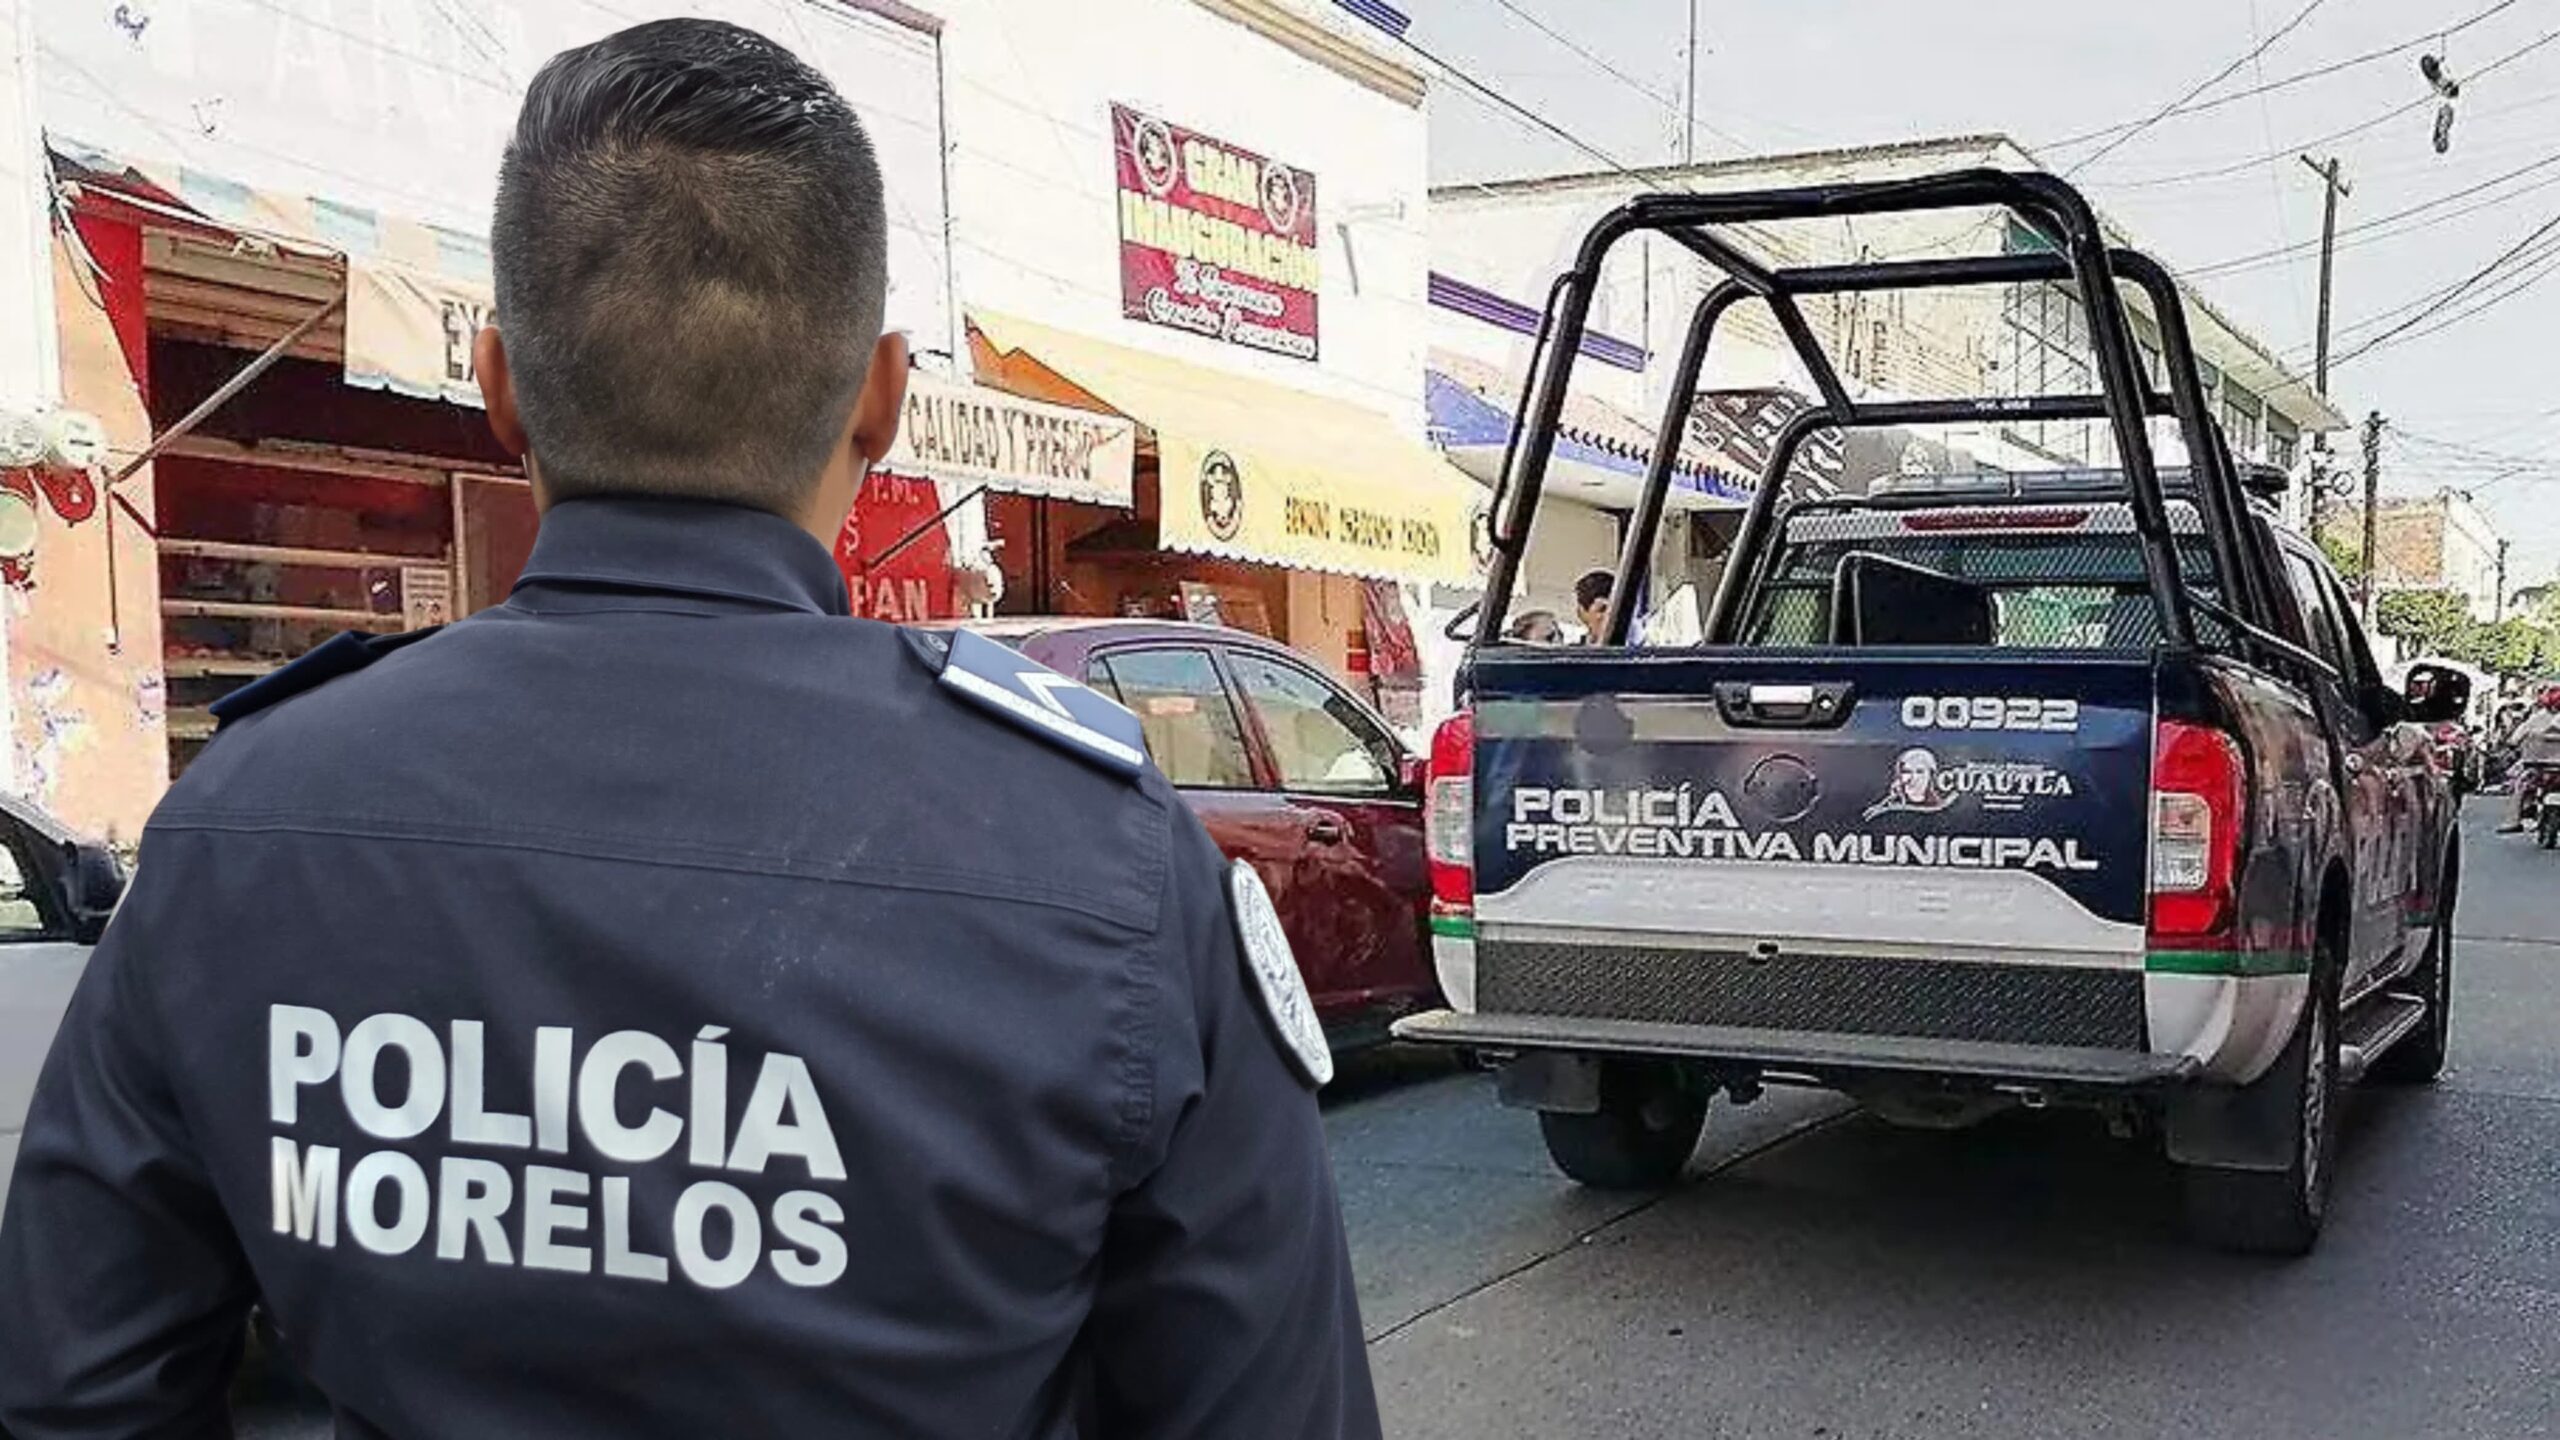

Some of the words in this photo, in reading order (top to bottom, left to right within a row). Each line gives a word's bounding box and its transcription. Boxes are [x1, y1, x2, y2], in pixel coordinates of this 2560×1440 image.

[1183, 139, 1260, 212] GRAN
[908, 392, 1000, 469] CALIDAD
[1003, 409, 1018, 474] Y
[1902, 696, 2078, 731] 00922
[1514, 782, 1739, 827] POLICÍA
[1937, 767, 2073, 795] CUAUTLA
[1506, 823, 1801, 860] PREVENTIVA
[1813, 833, 2099, 869] MUNICIPAL
[269, 1004, 848, 1180] POLICÍA
[271, 1136, 849, 1288] MORELOS
